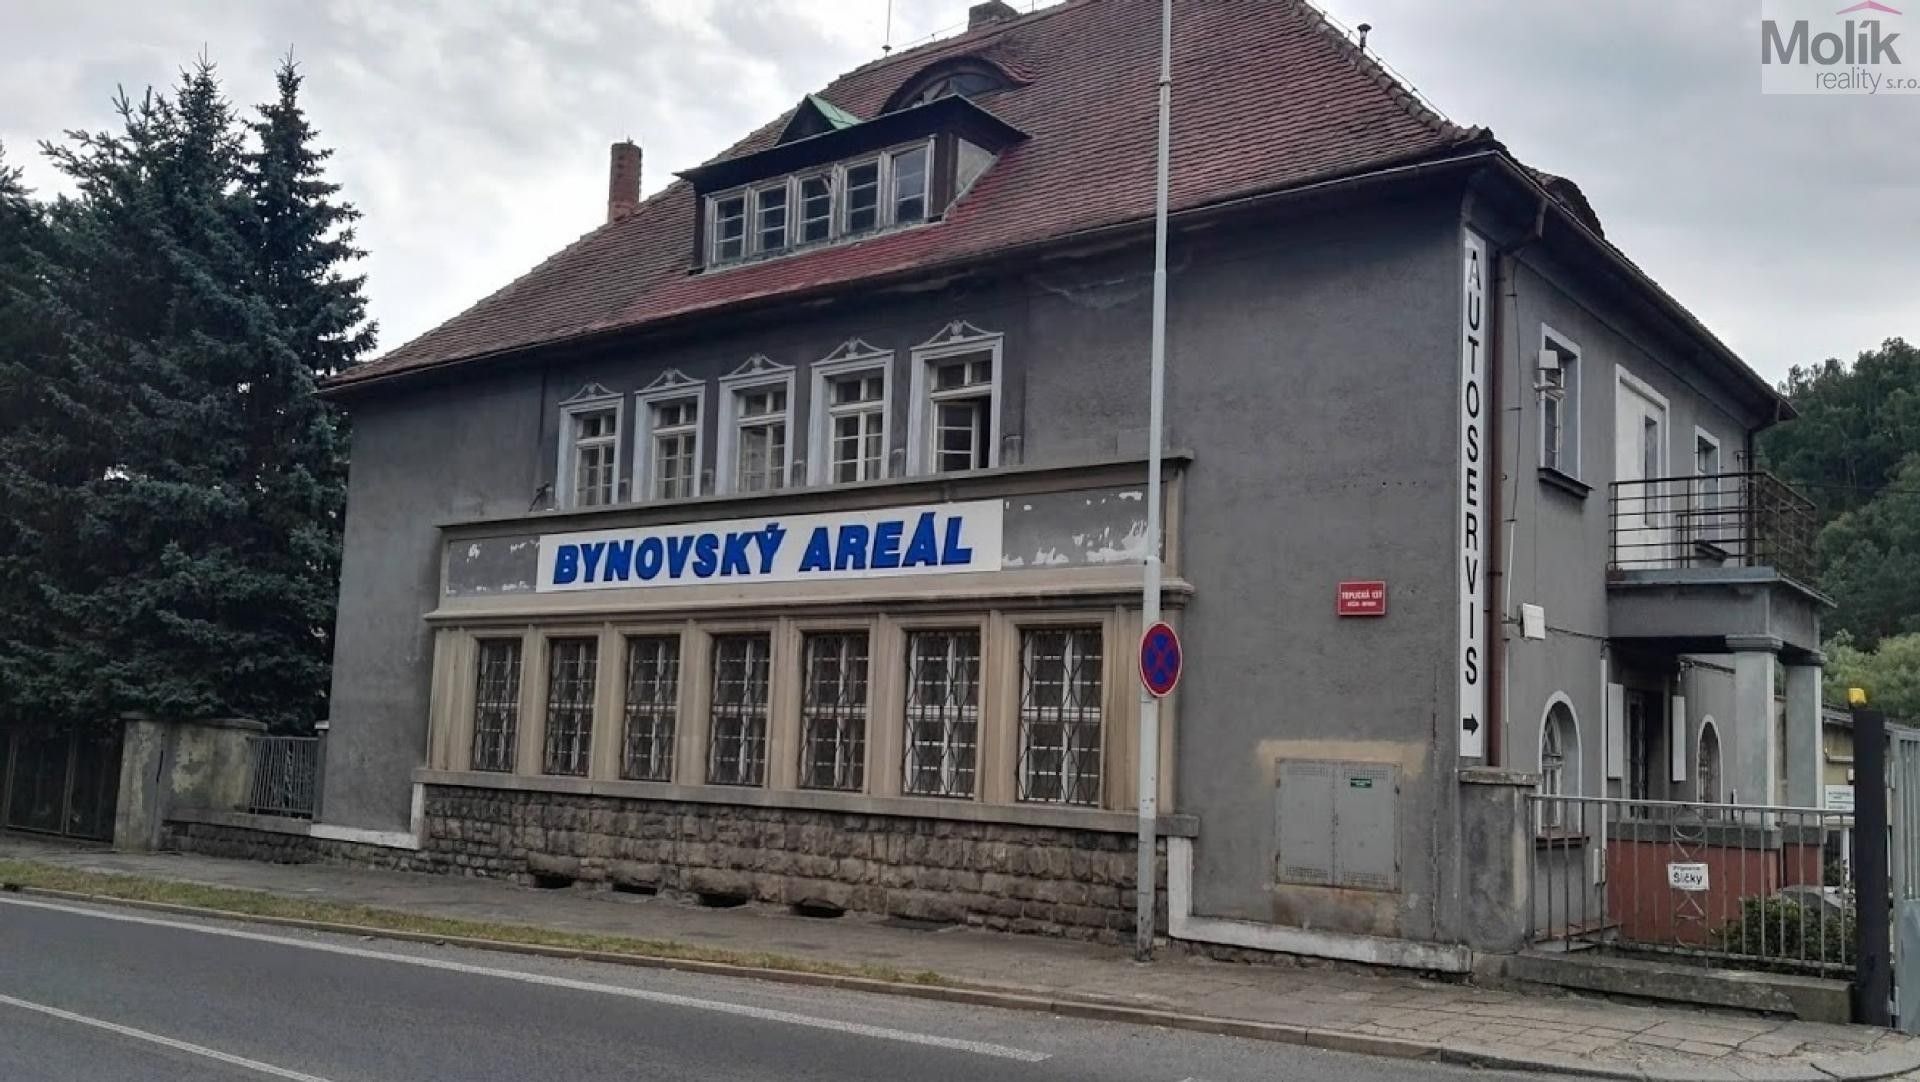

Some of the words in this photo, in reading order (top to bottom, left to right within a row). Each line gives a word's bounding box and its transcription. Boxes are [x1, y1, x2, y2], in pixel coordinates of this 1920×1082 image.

[553, 522, 787, 584] BYNOVSKÝ
[799, 512, 972, 571] AREÁL
[1465, 250, 1481, 685] AUTOSERVIS
